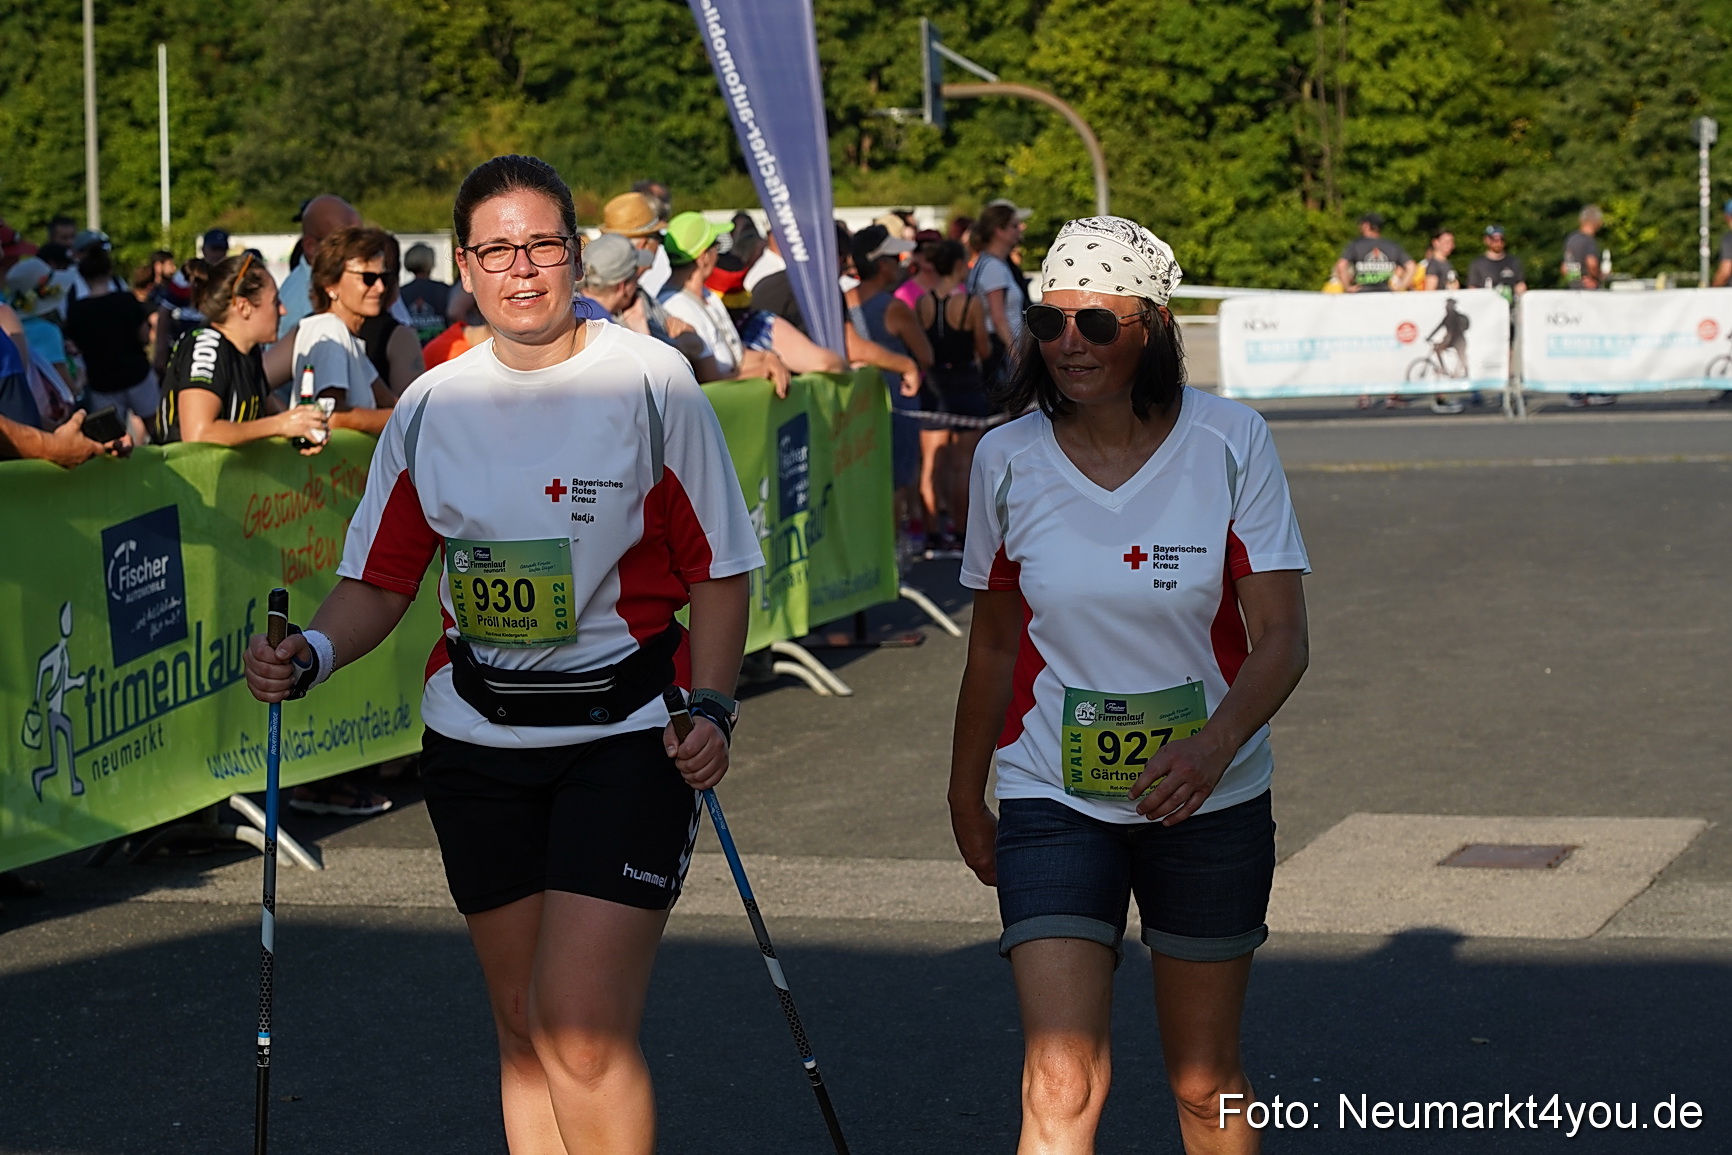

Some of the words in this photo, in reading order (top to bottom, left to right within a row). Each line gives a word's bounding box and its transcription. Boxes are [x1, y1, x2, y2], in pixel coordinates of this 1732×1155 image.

[571, 487, 597, 495] Rotes
[572, 478, 624, 488] Bayerisches
[243, 463, 326, 539] Gesunde
[571, 495, 597, 504] Kreuz
[571, 512, 595, 523] Nadja
[280, 525, 339, 586] laufen
[1152, 544, 1207, 554] Bayerisches
[1152, 553, 1179, 561] Rotes
[119, 555, 169, 592] Fischer
[470, 560, 506, 570] Firmenlauf
[1152, 561, 1179, 570] Kreuz
[472, 577, 536, 613] 930
[1153, 579, 1178, 591] Birgit
[453, 579, 469, 628] WALK
[553, 582, 568, 630] 2022
[477, 614, 499, 628] Pröll
[503, 616, 538, 630] Nadja
[85, 597, 256, 747] firmenlauf
[1098, 712, 1145, 722] Firmenlauf
[92, 722, 165, 781] neumarkt
[1097, 727, 1174, 766] 927
[1069, 732, 1083, 783] WALK
[622, 863, 668, 888] hummel
